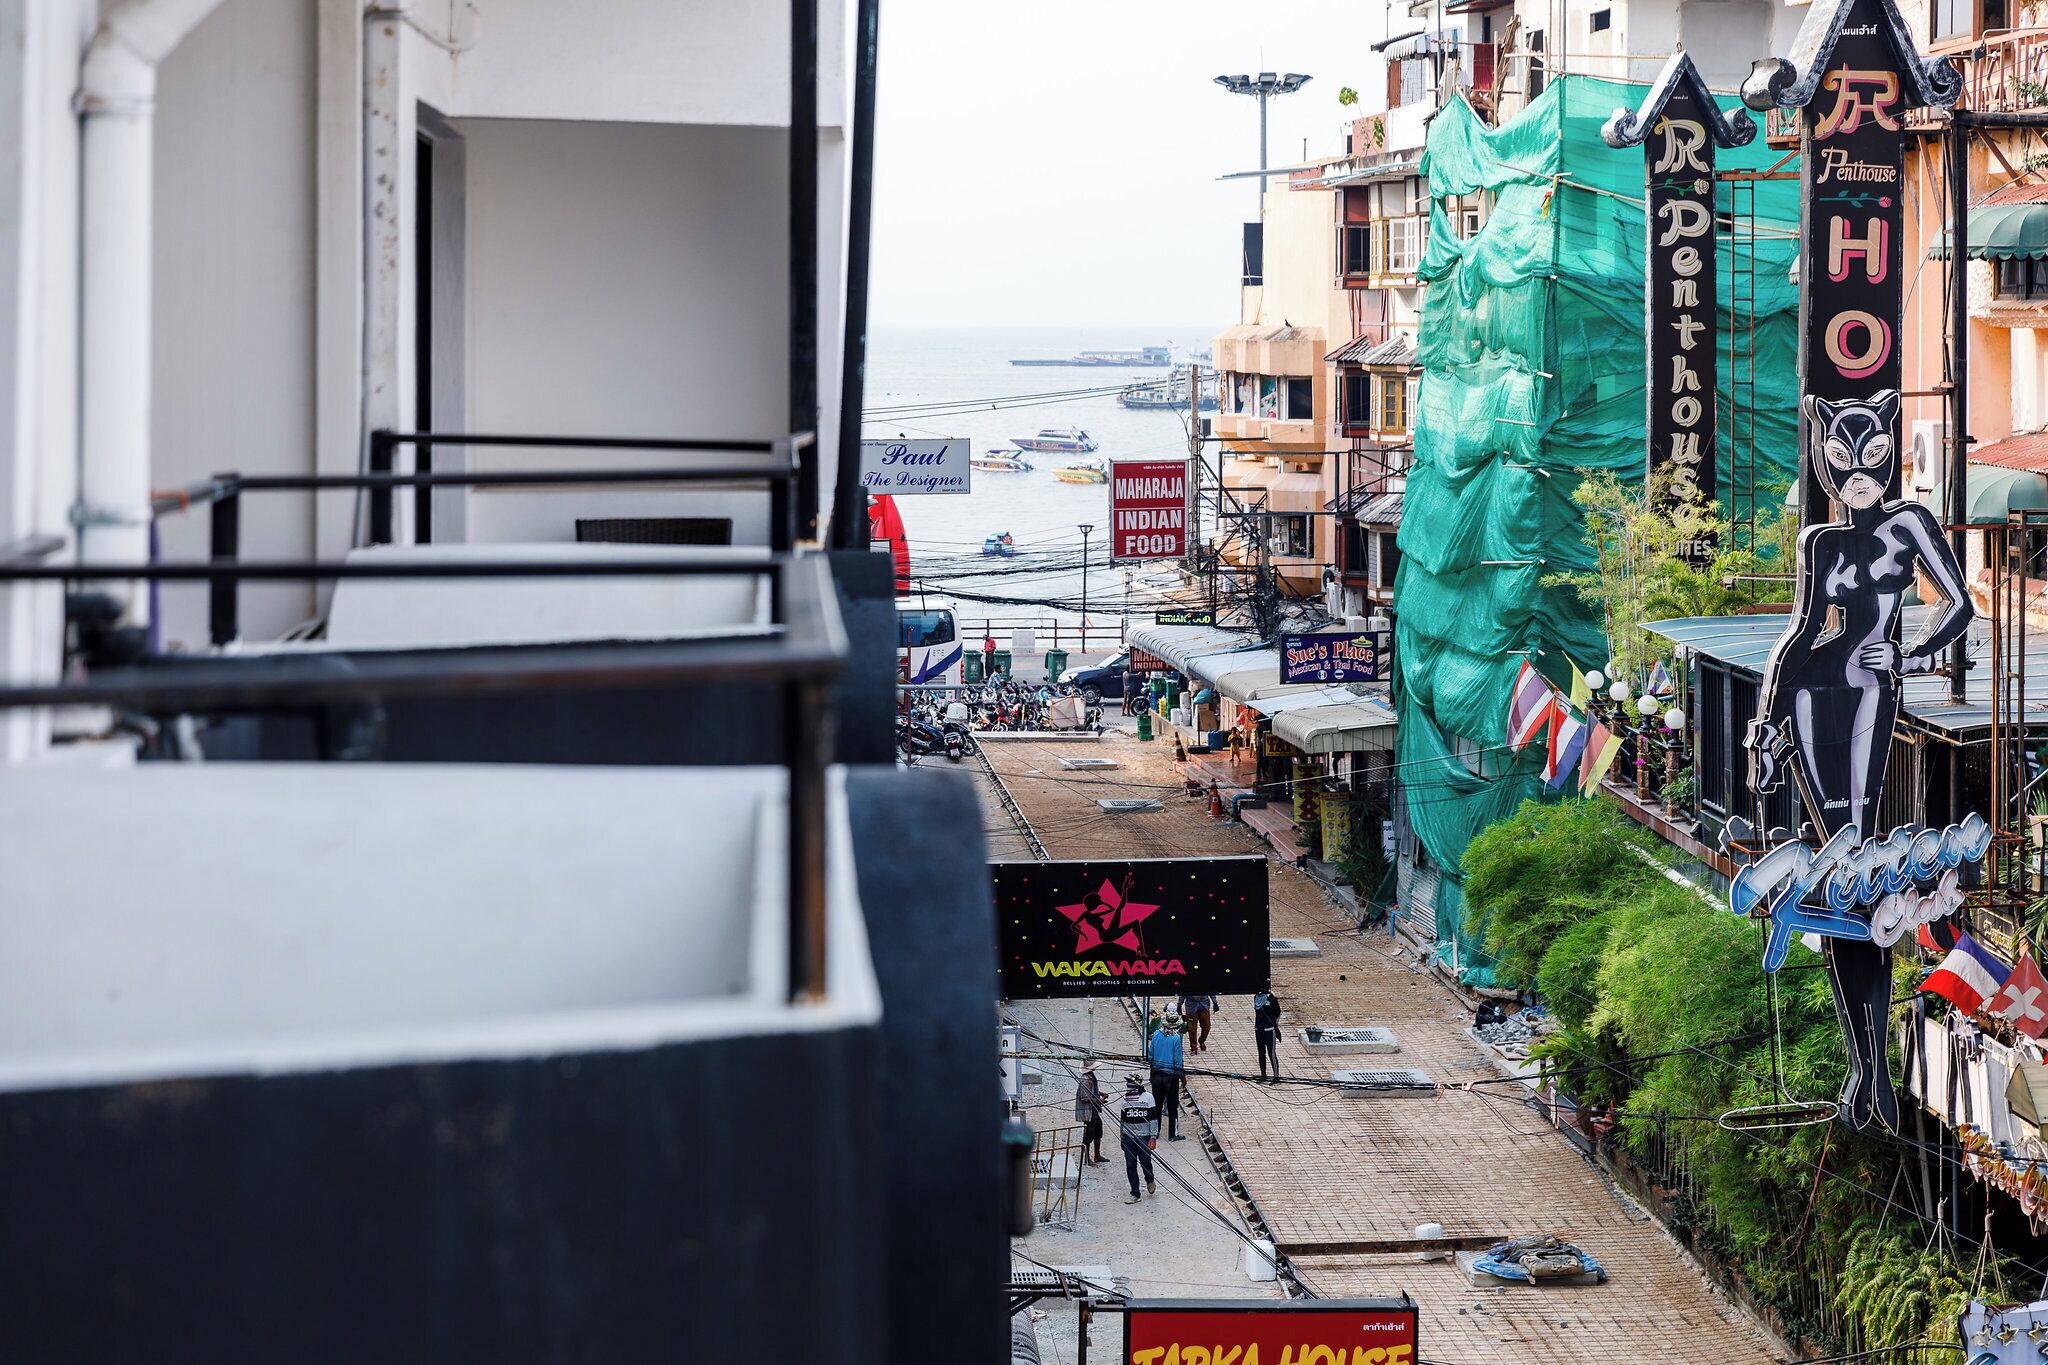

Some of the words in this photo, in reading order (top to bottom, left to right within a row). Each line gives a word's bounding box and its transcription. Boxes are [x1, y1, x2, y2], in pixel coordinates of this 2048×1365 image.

[1815, 62, 1900, 141] R
[1653, 114, 1711, 174] R
[1816, 145, 1898, 184] Penthouse
[881, 443, 949, 466] Paul
[862, 471, 892, 487] The
[896, 471, 964, 493] Designer
[1115, 476, 1184, 500] MAHARAJA
[1118, 509, 1182, 531] INDIAN
[1125, 534, 1176, 555] FOOD
[1671, 539, 1712, 556] UITES
[1286, 642, 1328, 667] Sue's
[1332, 640, 1374, 663] Place
[1133, 661, 1163, 670] INDIAN
[1287, 662, 1322, 678] Mexican
[1323, 660, 1331, 670] &
[1332, 659, 1351, 670] Thai
[1353, 661, 1374, 675] Food
[1729, 811, 1993, 974] Kitten
[1870, 868, 1966, 948] Club
